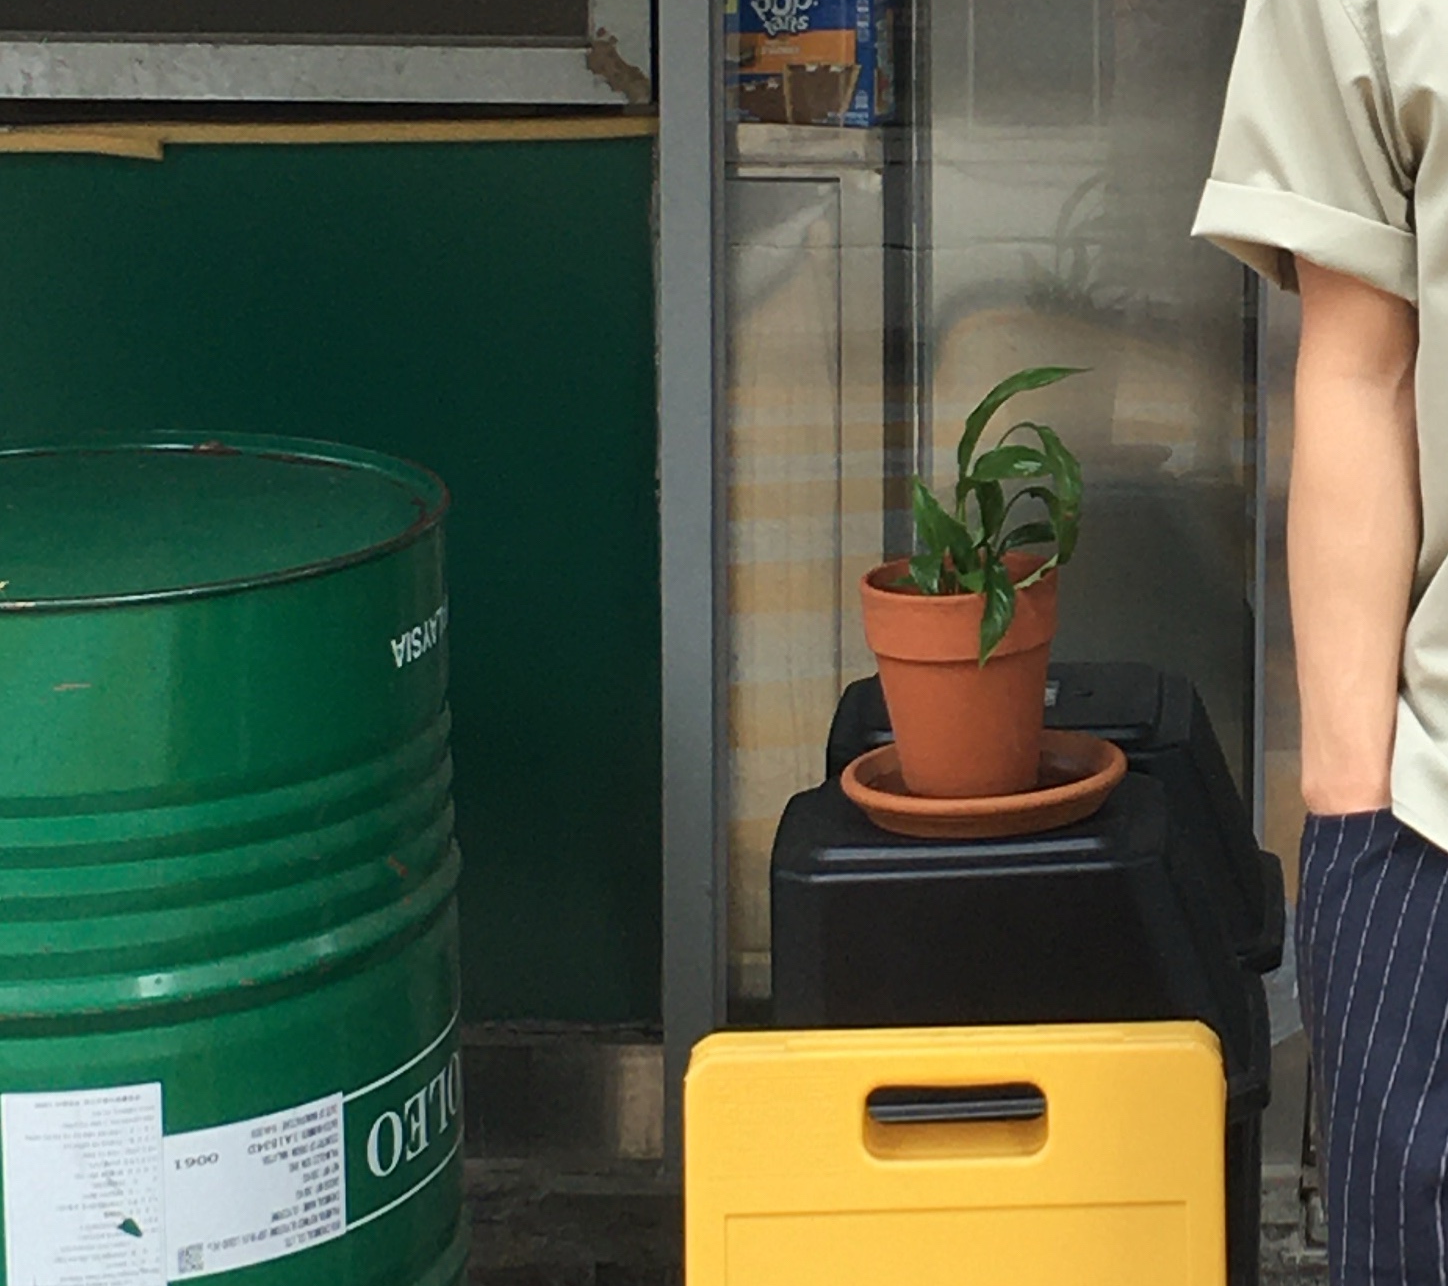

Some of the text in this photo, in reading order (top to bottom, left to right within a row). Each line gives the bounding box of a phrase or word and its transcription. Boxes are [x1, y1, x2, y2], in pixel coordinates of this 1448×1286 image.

[391, 602, 449, 669] LAYSIA
[366, 1051, 461, 1178] OLEO
[174, 1151, 220, 1171] 0061
